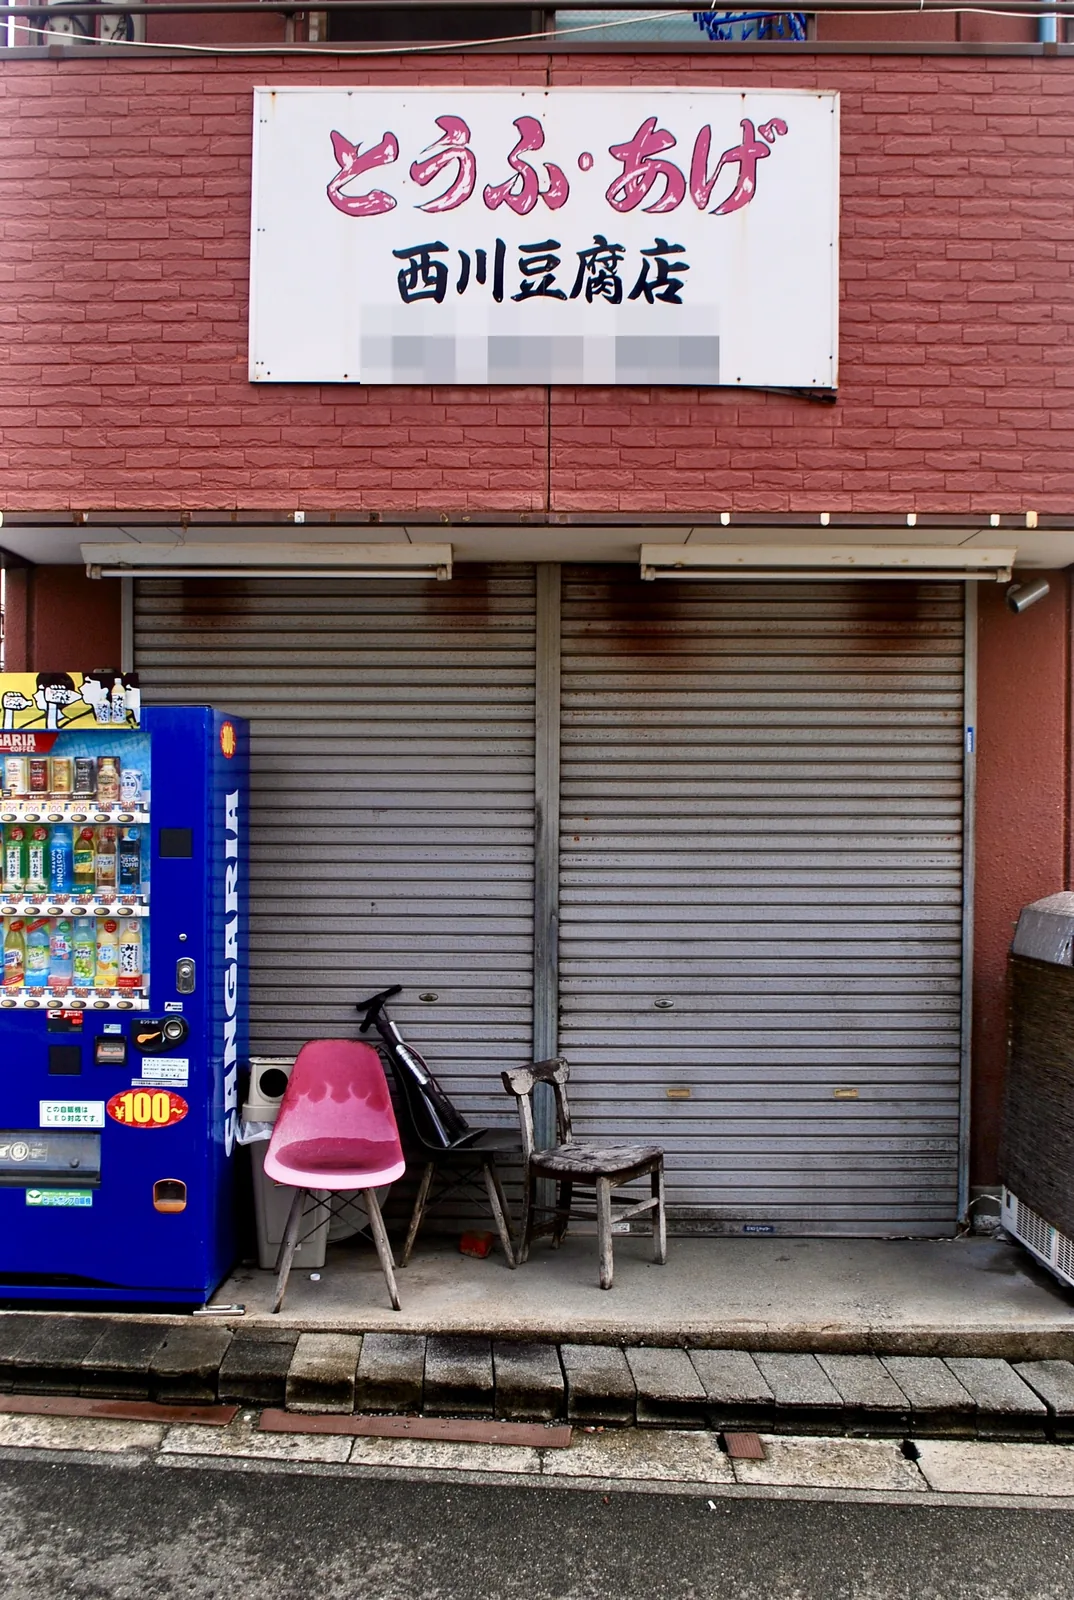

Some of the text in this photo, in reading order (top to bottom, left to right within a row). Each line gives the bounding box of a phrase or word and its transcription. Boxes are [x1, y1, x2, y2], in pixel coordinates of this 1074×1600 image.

[327, 114, 788, 217] とうふ・あげ
[392, 234, 690, 304] 西川豆腐店
[56, 848, 64, 888] POSTONIC
[223, 789, 239, 1158] SANGARIA
